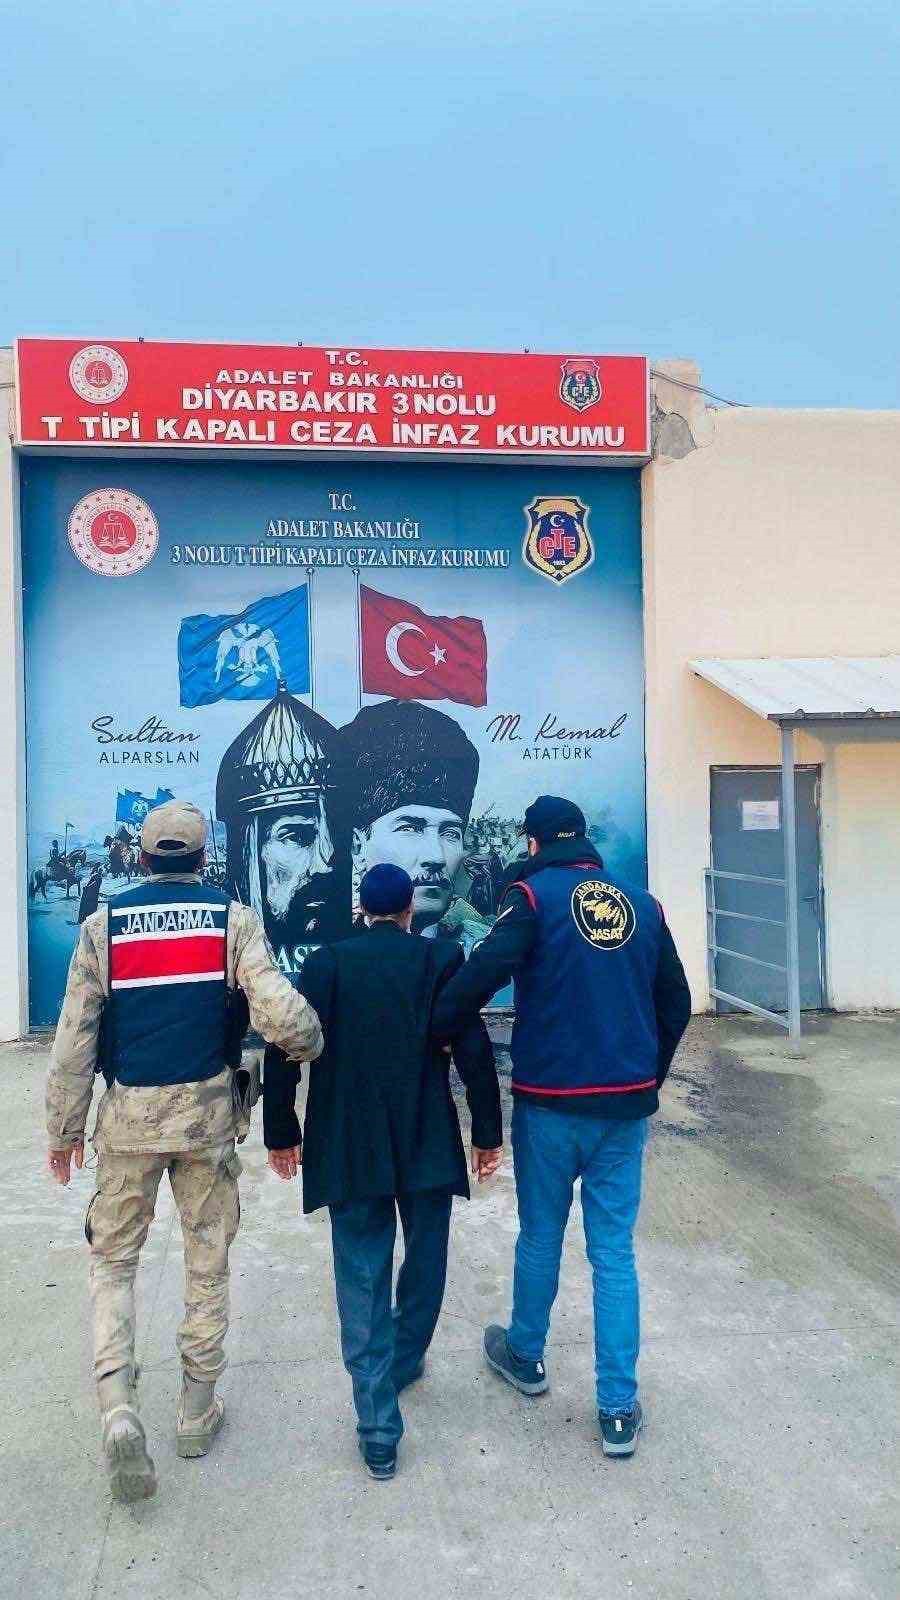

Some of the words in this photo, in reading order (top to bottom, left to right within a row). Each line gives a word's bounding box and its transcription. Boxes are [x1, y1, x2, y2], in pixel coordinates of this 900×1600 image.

[325, 351, 369, 367] T.C.
[215, 369, 313, 385] ADALET
[329, 372, 464, 390] BAKANLIĞI
[182, 383, 378, 414] DİYARBAKIR
[392, 392, 408, 415] 3
[414, 393, 497, 416] NOLU
[41, 416, 63, 438] T
[79, 411, 140, 440] TİPİ
[156, 417, 275, 442] KAPALI
[290, 420, 378, 445] CEZA
[392, 416, 480, 446] İNFAZ
[496, 424, 625, 448] KURUMU
[328, 493, 356, 511] T.C.
[266, 520, 329, 537] ADALET
[333, 517, 421, 539] BAKANLIĞI
[171, 546, 183, 564] 3
[185, 547, 232, 564] NOLU
[233, 548, 245, 563] T
[248, 543, 284, 565] TİPİ
[286, 548, 344, 566] KAPALI
[347, 548, 387, 567] CEZA
[391, 545, 440, 567] İNFAZ
[440, 549, 511, 568] KURUMU
[91, 715, 201, 743] Sultan
[485, 714, 522, 743] M.
[534, 713, 628, 743] Kemal
[99, 750, 200, 764] ALPARSLAN
[522, 745, 593, 760] ATATÜRK
[121, 909, 216, 935] JANDARMA
[590, 928, 625, 941] JASAT
